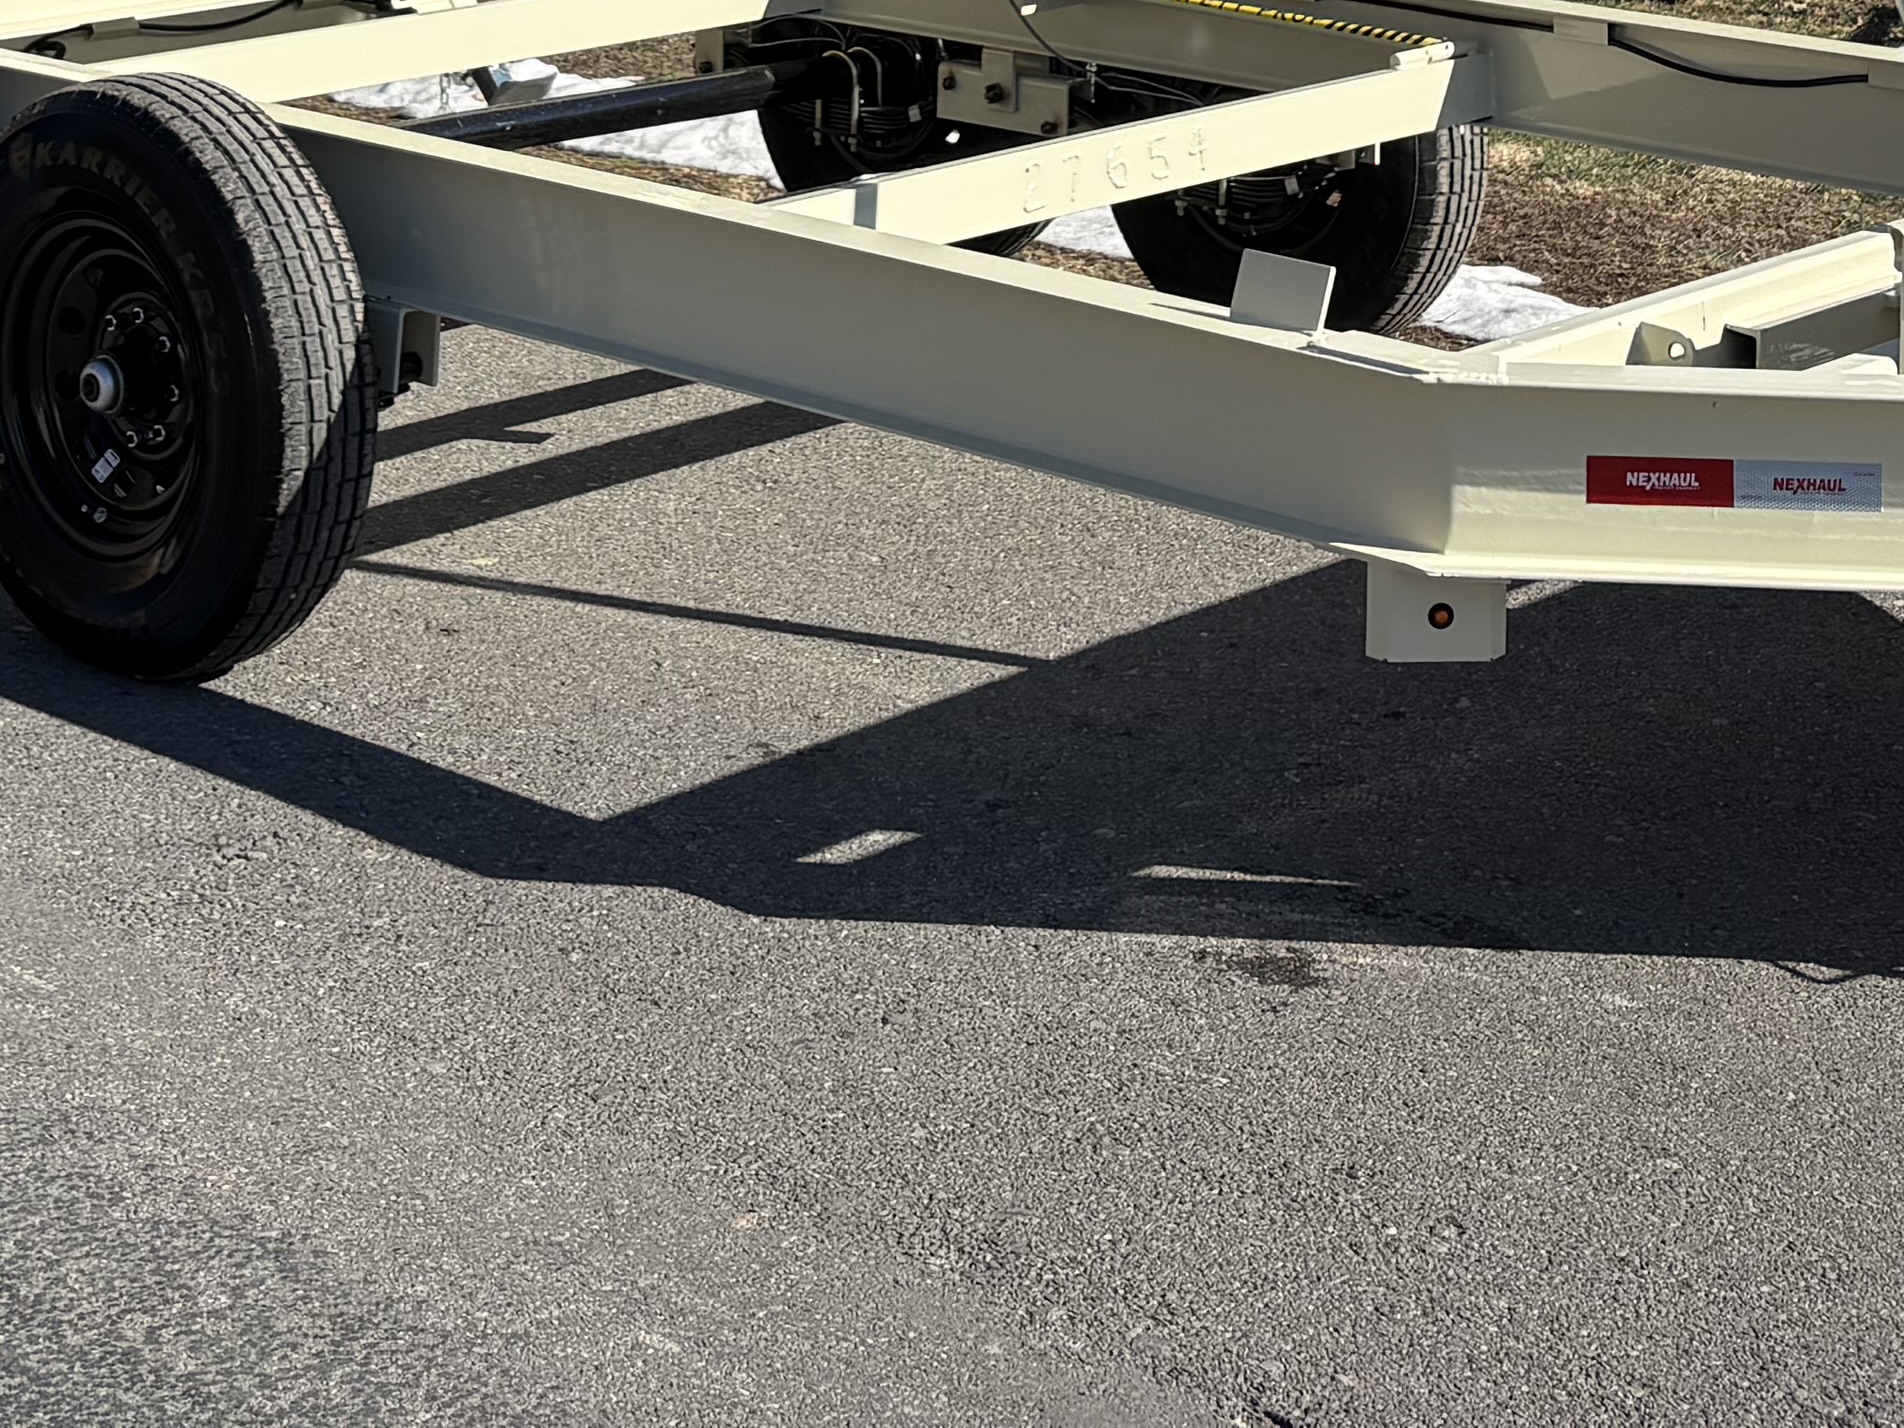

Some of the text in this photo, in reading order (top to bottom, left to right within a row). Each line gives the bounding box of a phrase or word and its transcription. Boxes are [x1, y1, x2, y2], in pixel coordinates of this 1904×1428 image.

[33, 141, 177, 240] KARRIER
[1625, 471, 1700, 491] NEXHAUL
[1772, 477, 1847, 496] NEXHAUL
